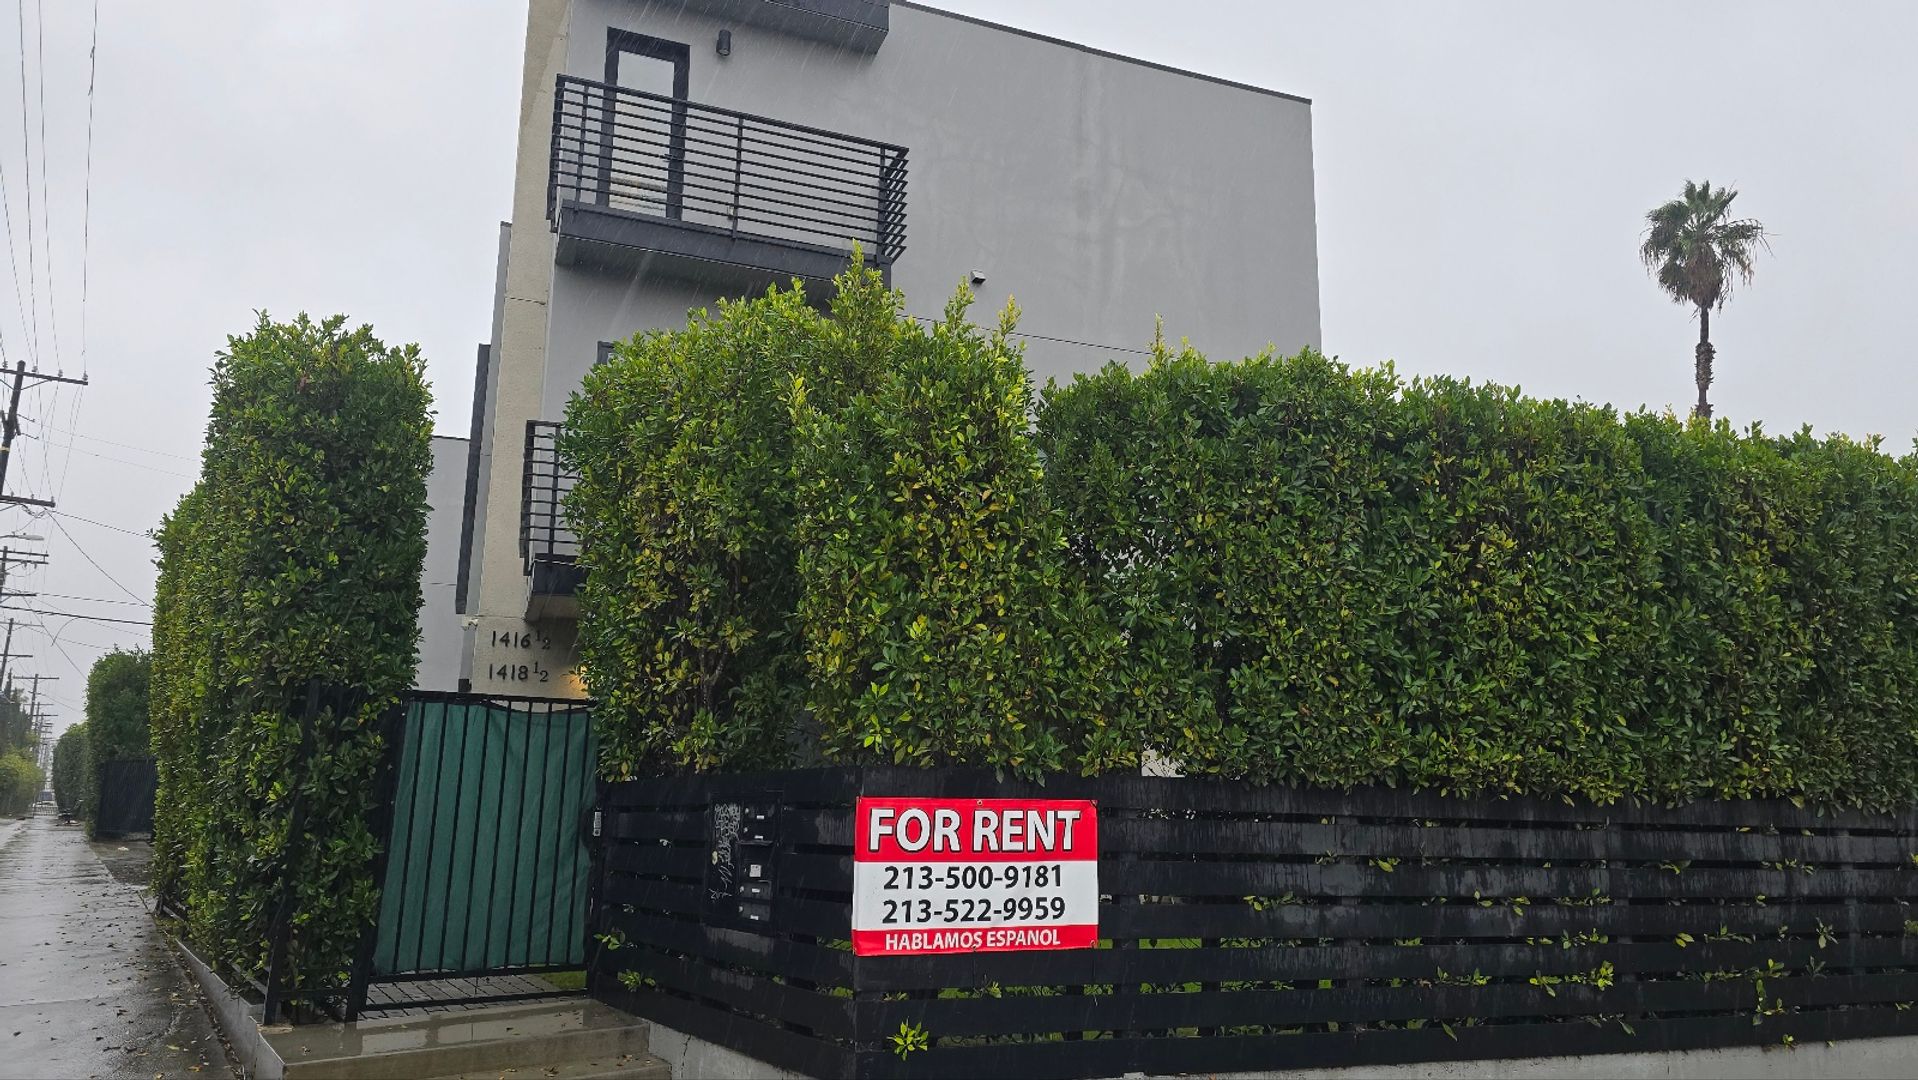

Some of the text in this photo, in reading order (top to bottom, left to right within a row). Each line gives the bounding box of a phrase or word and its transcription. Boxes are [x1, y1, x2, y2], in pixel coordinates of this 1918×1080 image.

[491, 630, 531, 649] 1416
[489, 663, 529, 681] 1418
[868, 808, 1081, 852] FOR RENT
[883, 864, 1062, 891] 213-500-9181
[882, 896, 1066, 924] 213-522-9959
[885, 929, 1061, 951] HABLAMOS ESPANOL
